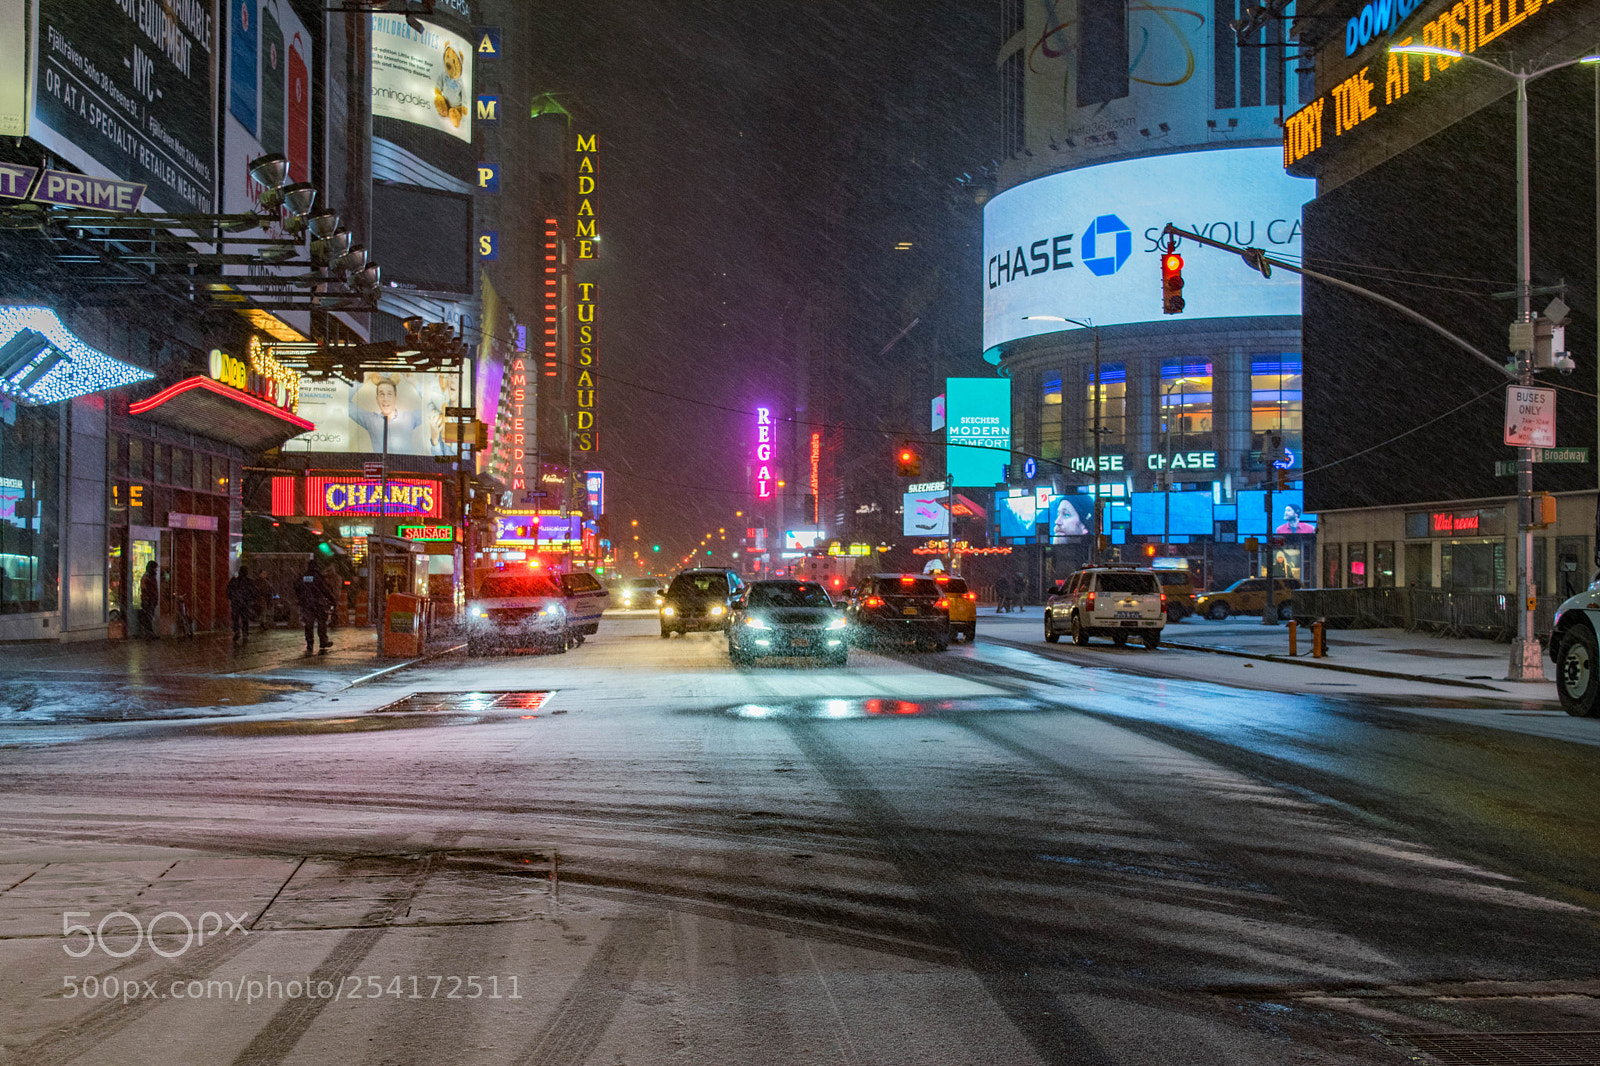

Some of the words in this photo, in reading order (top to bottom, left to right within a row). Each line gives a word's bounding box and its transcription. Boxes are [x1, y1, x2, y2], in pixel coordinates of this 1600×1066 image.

[84, 57, 101, 85] Soho
[134, 44, 154, 102] NYC
[47, 69, 61, 98] OR
[64, 83, 77, 110] AT
[80, 96, 87, 119] A
[90, 103, 138, 159] SPECIALTY
[140, 144, 177, 191] RETAILER
[178, 175, 197, 207] NEAR
[48, 175, 134, 209] PRIME
[576, 134, 597, 259] MADAME
[988, 233, 1074, 291] CHASE
[1191, 219, 1256, 247] YOU
[577, 283, 596, 451] TUSSAUDS
[1516, 392, 1546, 404] BUSES
[960, 417, 1001, 425] SKECHERS
[1519, 405, 1542, 416] ONLY
[512, 358, 526, 490] AMSTERDAM
[950, 427, 1011, 437] MODERN
[757, 407, 771, 497] REGAL
[950, 439, 1011, 449] COMFORT
[1072, 455, 1124, 473] CHASE
[1147, 452, 1217, 470] CHASE
[1545, 450, 1586, 464] Broadway
[325, 484, 435, 512] CHAMPS
[908, 482, 947, 493] SKECHERS
[405, 527, 451, 541] SAUSAGE
